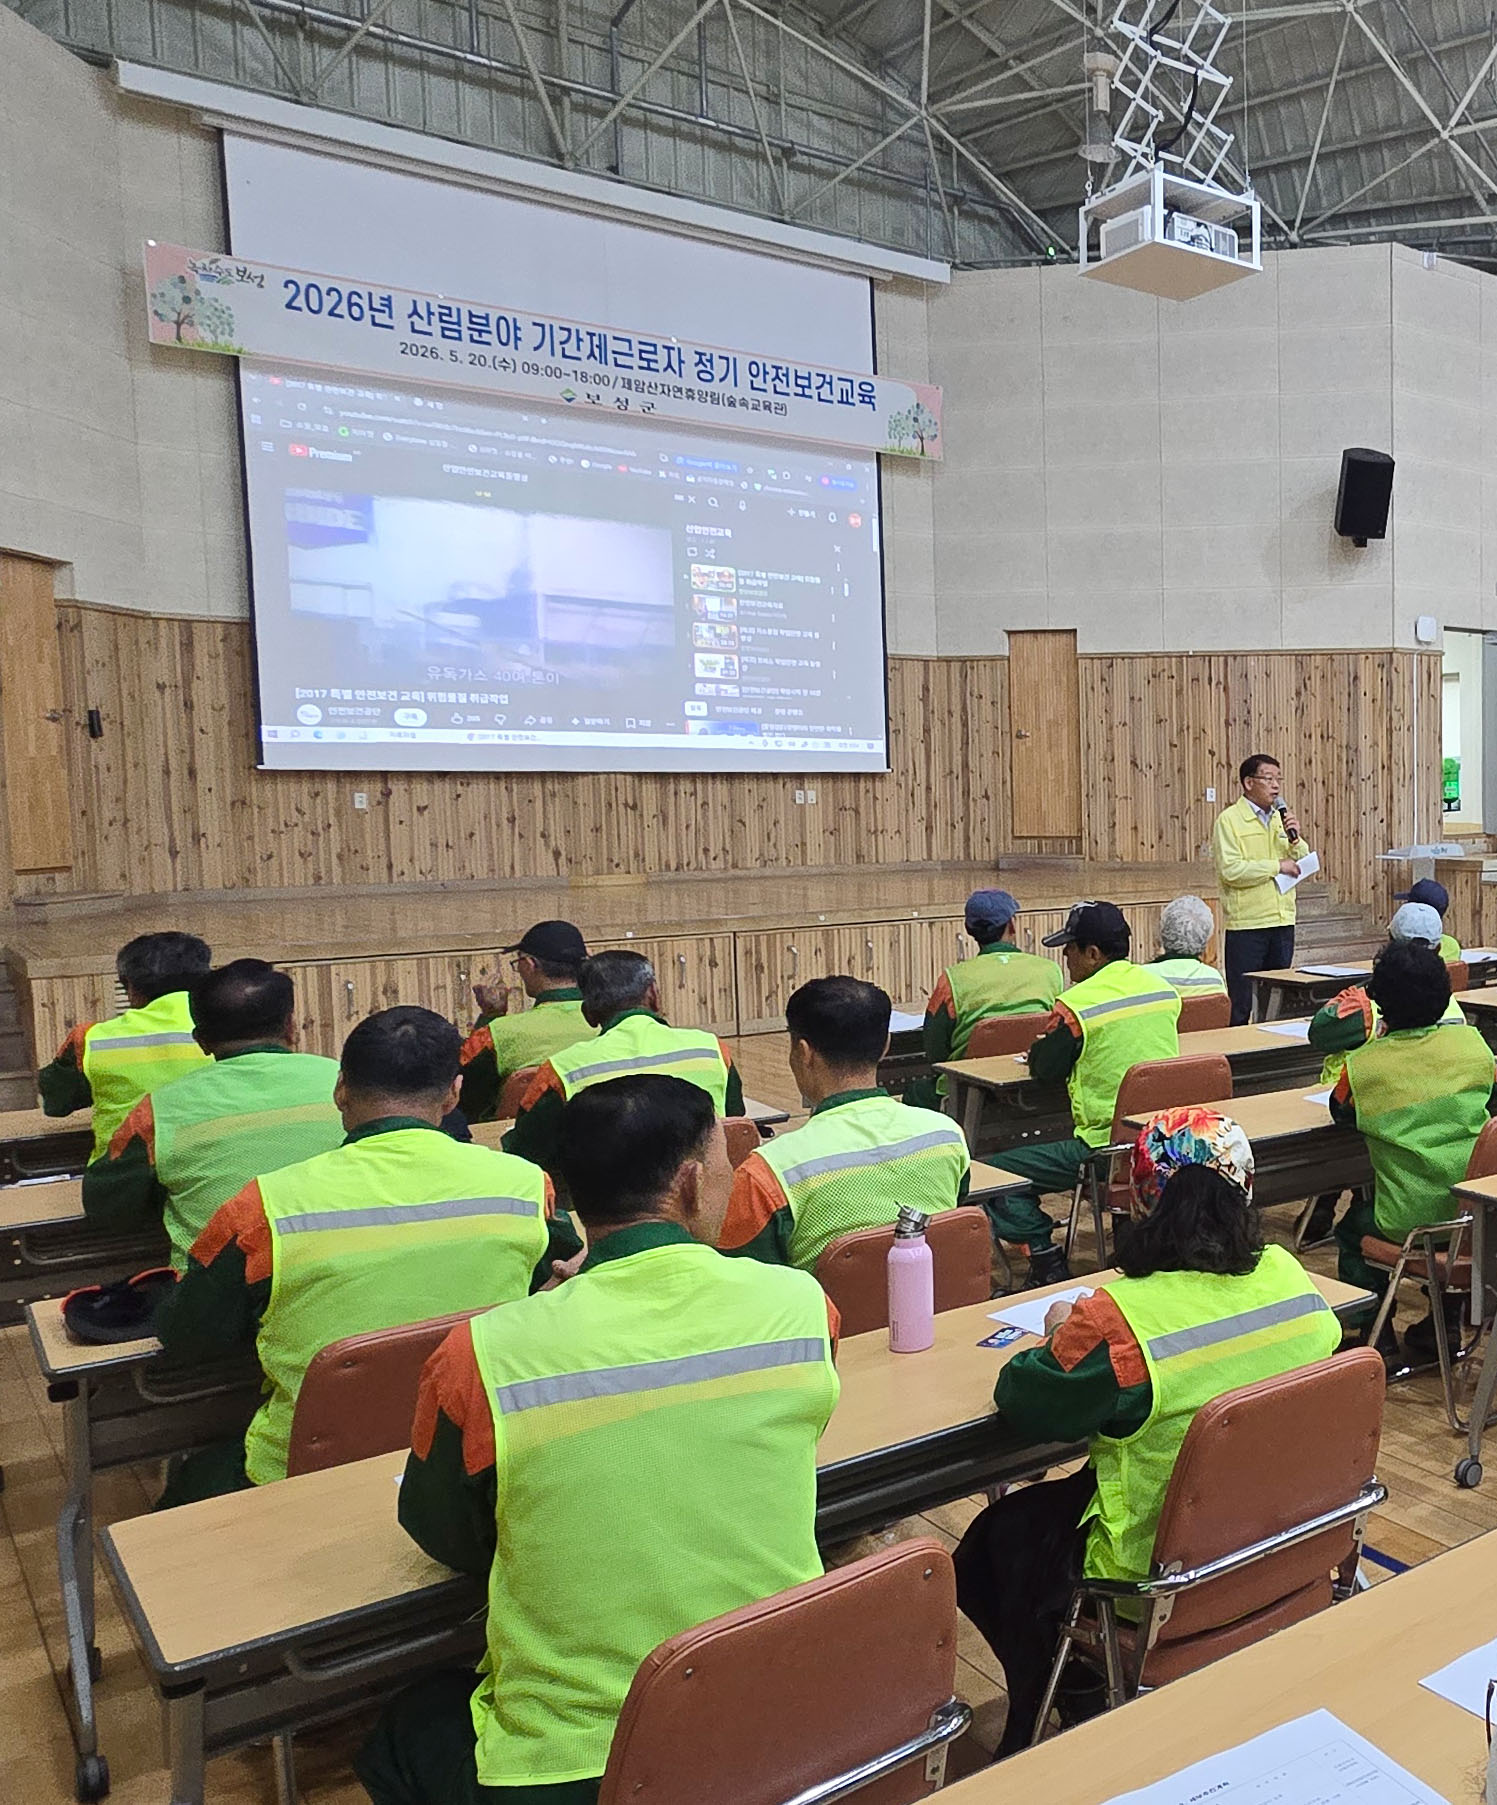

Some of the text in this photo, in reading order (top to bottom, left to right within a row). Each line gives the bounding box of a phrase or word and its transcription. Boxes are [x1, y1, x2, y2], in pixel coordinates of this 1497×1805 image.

[235, 266, 265, 289] 보성
[283, 279, 877, 412] 2026년 산림분야 기간제근로자 정기 안전보건교육
[400, 342, 444, 360] 2026.
[449, 350, 463, 364] 5.
[468, 353, 517, 374] 20.(수)
[427, 665, 489, 681] 유독가스
[295, 687, 328, 700] [2017
[354, 689, 398, 701] 안전보건
[400, 690, 425, 703] 교육]
